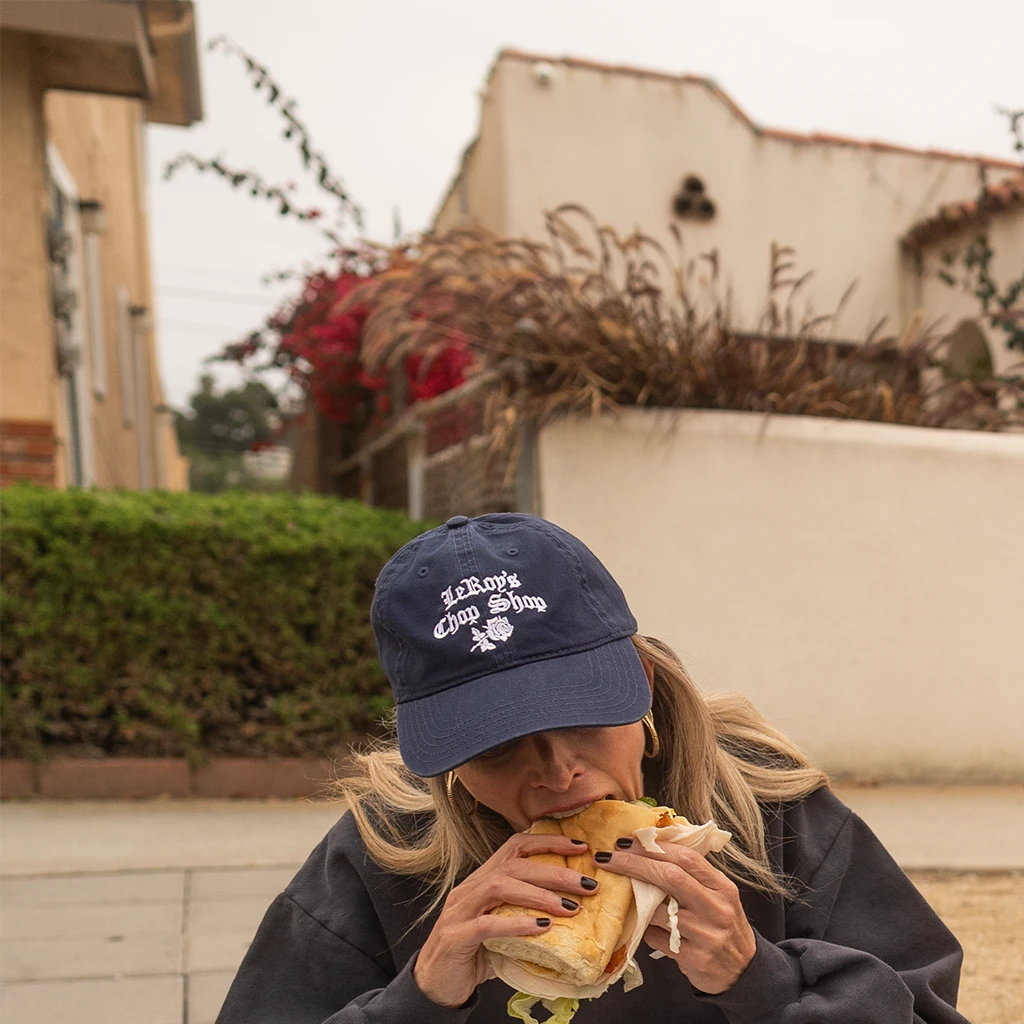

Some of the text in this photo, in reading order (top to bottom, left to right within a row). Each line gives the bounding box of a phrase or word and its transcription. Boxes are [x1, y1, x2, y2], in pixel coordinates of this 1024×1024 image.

[441, 570, 521, 611] LeRoy's
[433, 590, 548, 639] Chop Shop
